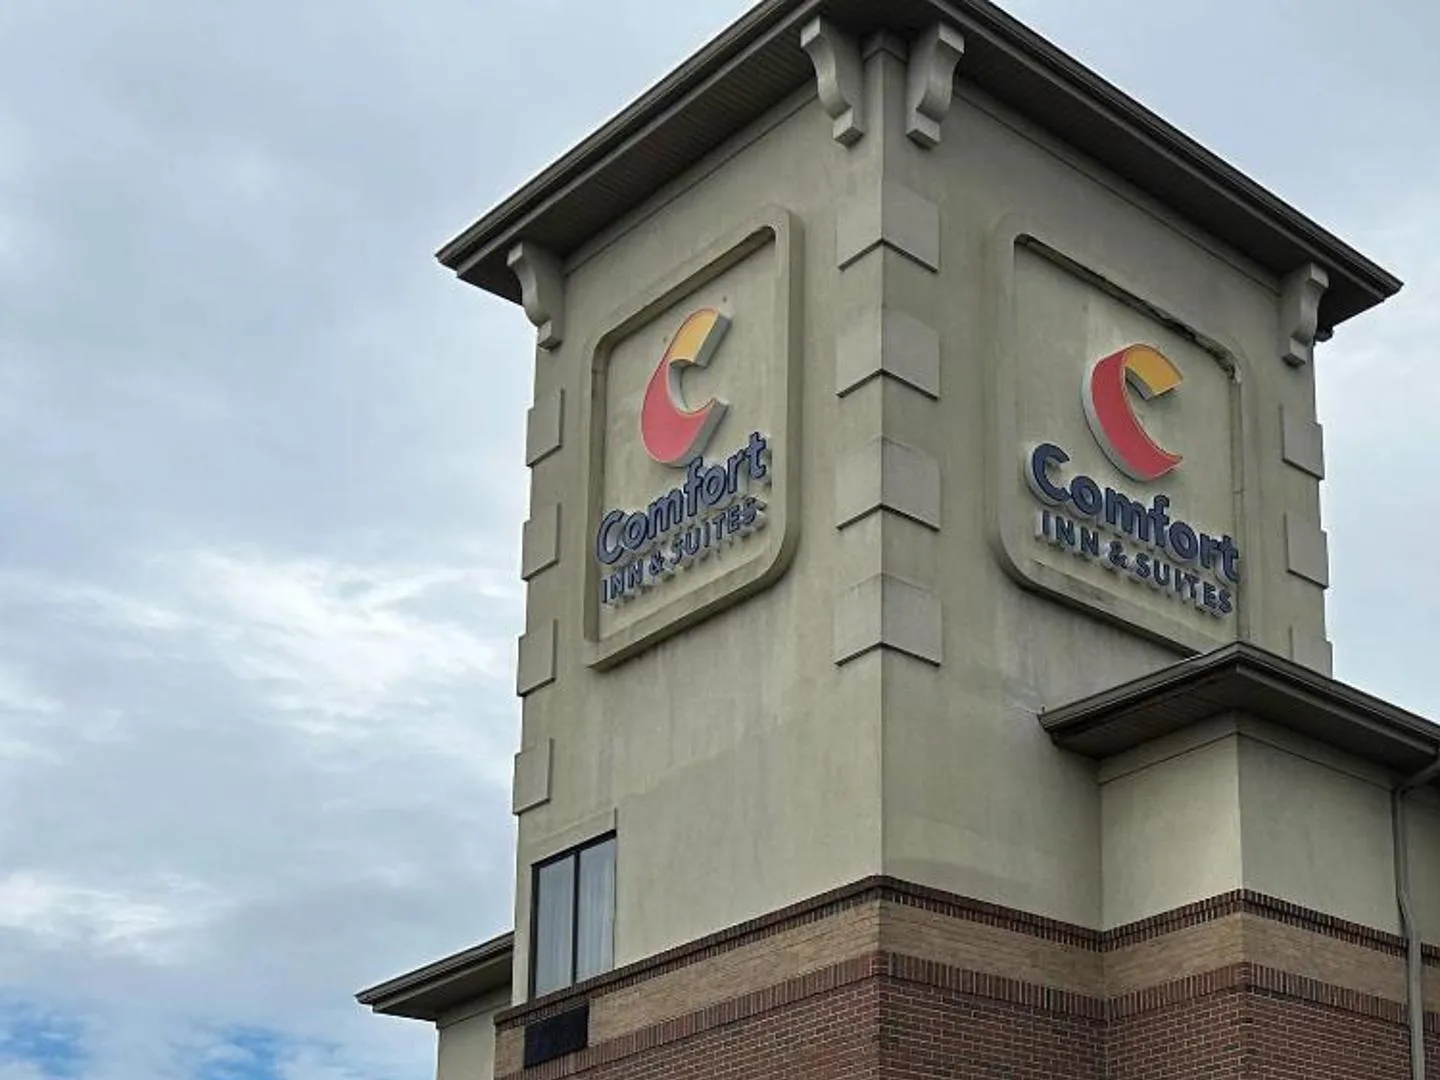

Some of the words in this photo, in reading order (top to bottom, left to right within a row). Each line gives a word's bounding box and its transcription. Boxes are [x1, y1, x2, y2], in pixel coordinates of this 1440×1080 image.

[597, 431, 768, 565] Comfort
[601, 562, 644, 603] INN
[648, 552, 667, 578] &
[668, 497, 764, 566] SUITES
[1029, 443, 1240, 583] Comfort
[1040, 509, 1100, 558] INN
[1108, 540, 1129, 567] &
[1136, 552, 1233, 614] SUITES
